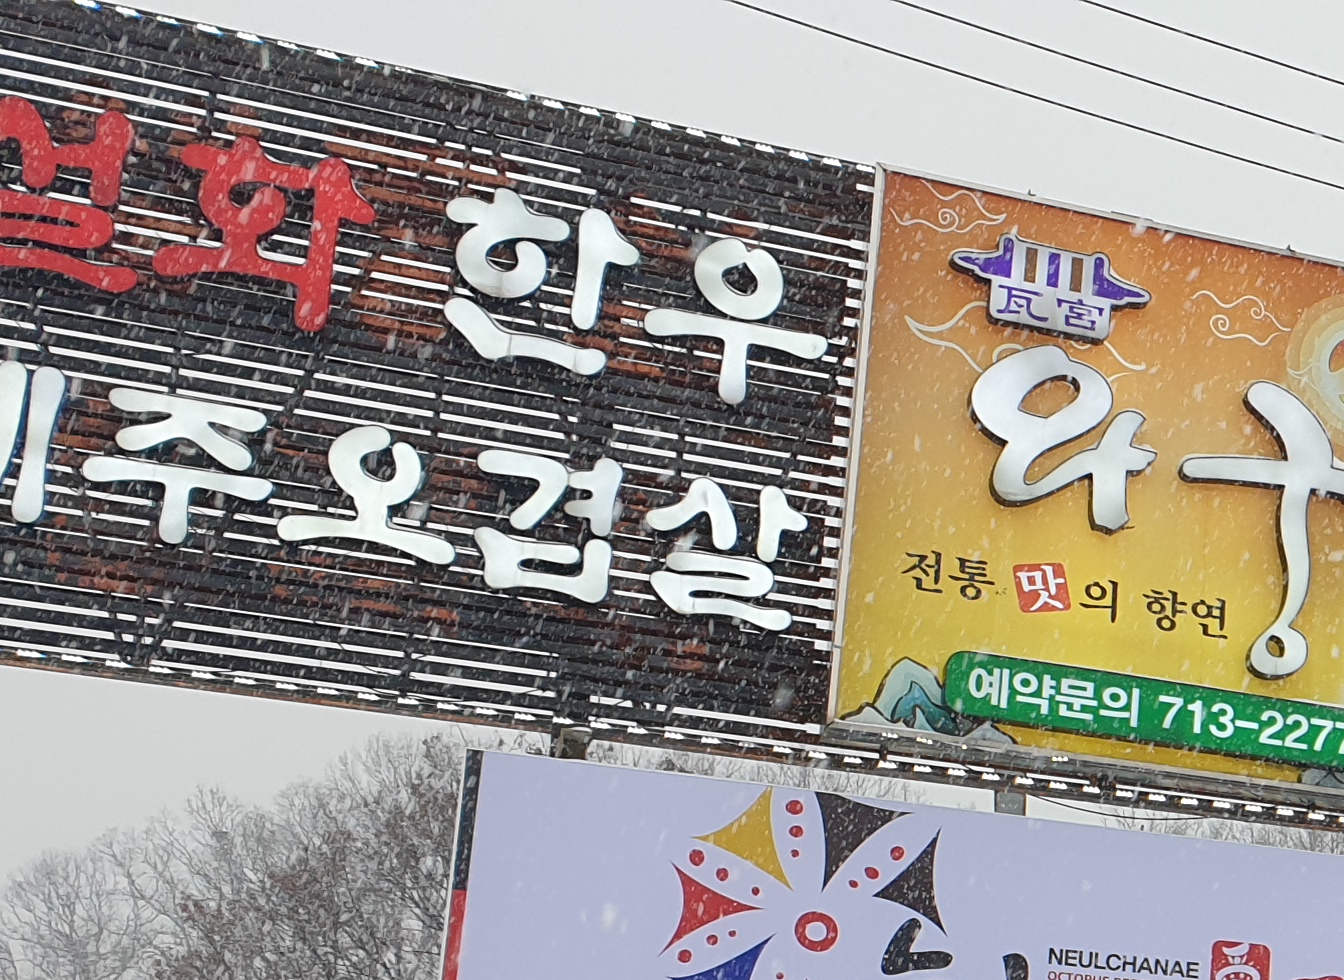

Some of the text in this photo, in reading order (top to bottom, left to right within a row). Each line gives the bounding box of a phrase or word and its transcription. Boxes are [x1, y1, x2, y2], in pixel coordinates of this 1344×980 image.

[444, 187, 828, 404] 한우
[995, 284, 1104, 333] 瓦宮
[901, 550, 995, 601] 전통
[1142, 588, 1229, 640] 향연
[967, 663, 1141, 730] 예약문의
[1048, 947, 1200, 979] NEULCHANAE
